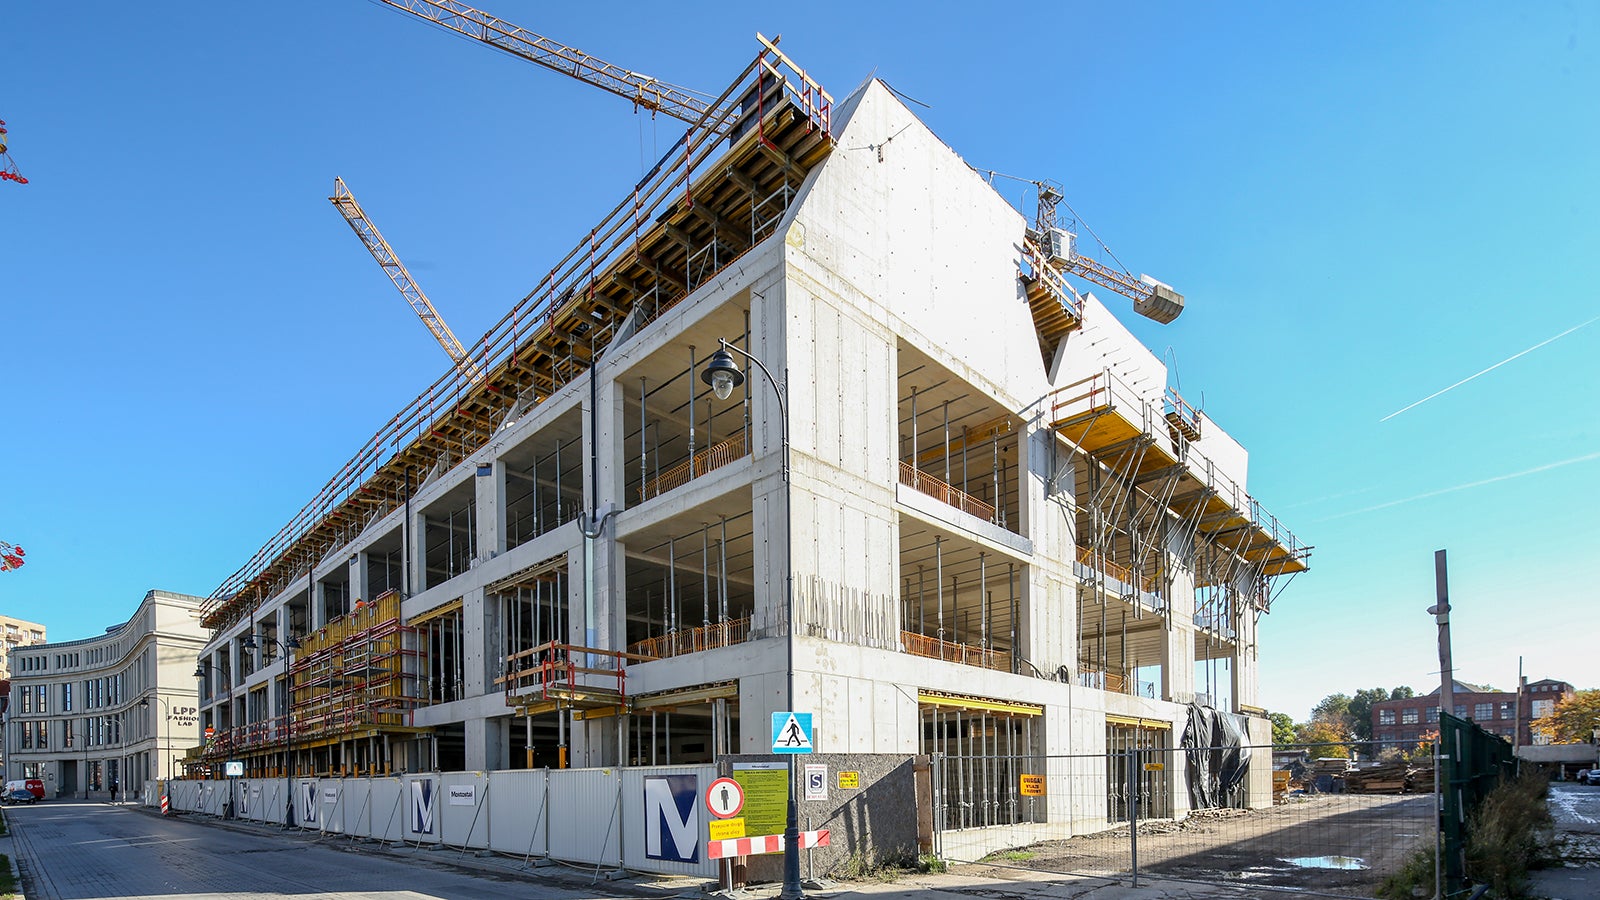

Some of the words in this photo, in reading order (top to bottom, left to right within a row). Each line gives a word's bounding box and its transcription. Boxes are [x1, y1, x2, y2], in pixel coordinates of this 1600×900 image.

[173, 706, 197, 715] LPP
[411, 781, 433, 832] M
[646, 778, 698, 859] M
